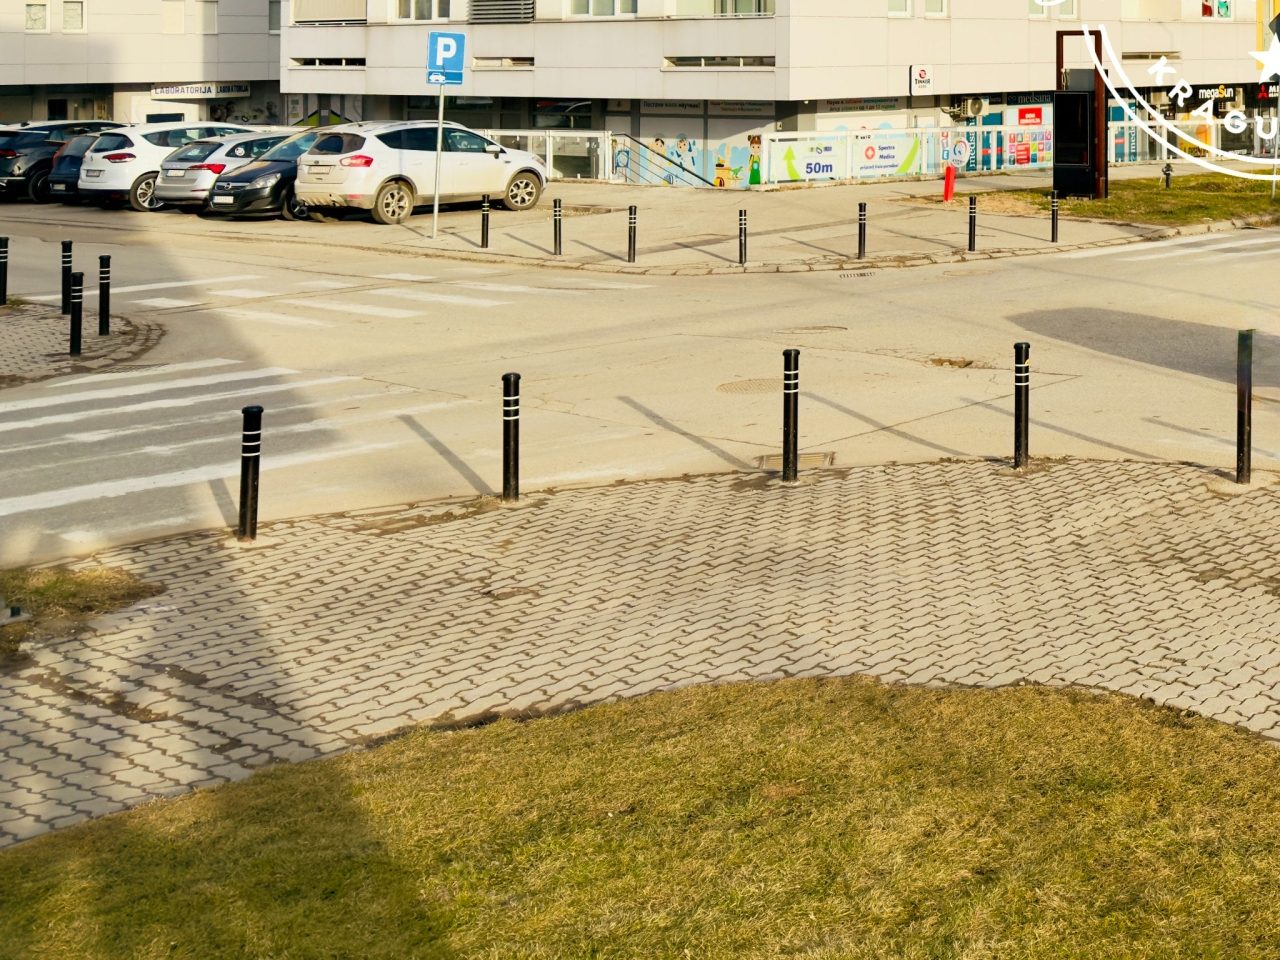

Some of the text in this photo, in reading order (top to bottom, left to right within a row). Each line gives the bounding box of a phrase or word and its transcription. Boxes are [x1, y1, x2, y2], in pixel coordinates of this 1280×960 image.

[436, 36, 457, 66] P
[154, 86, 212, 95] LABORATORIJA
[1198, 84, 1234, 100] megaSun
[1018, 91, 1051, 103] medsana
[805, 162, 833, 174] 50m
